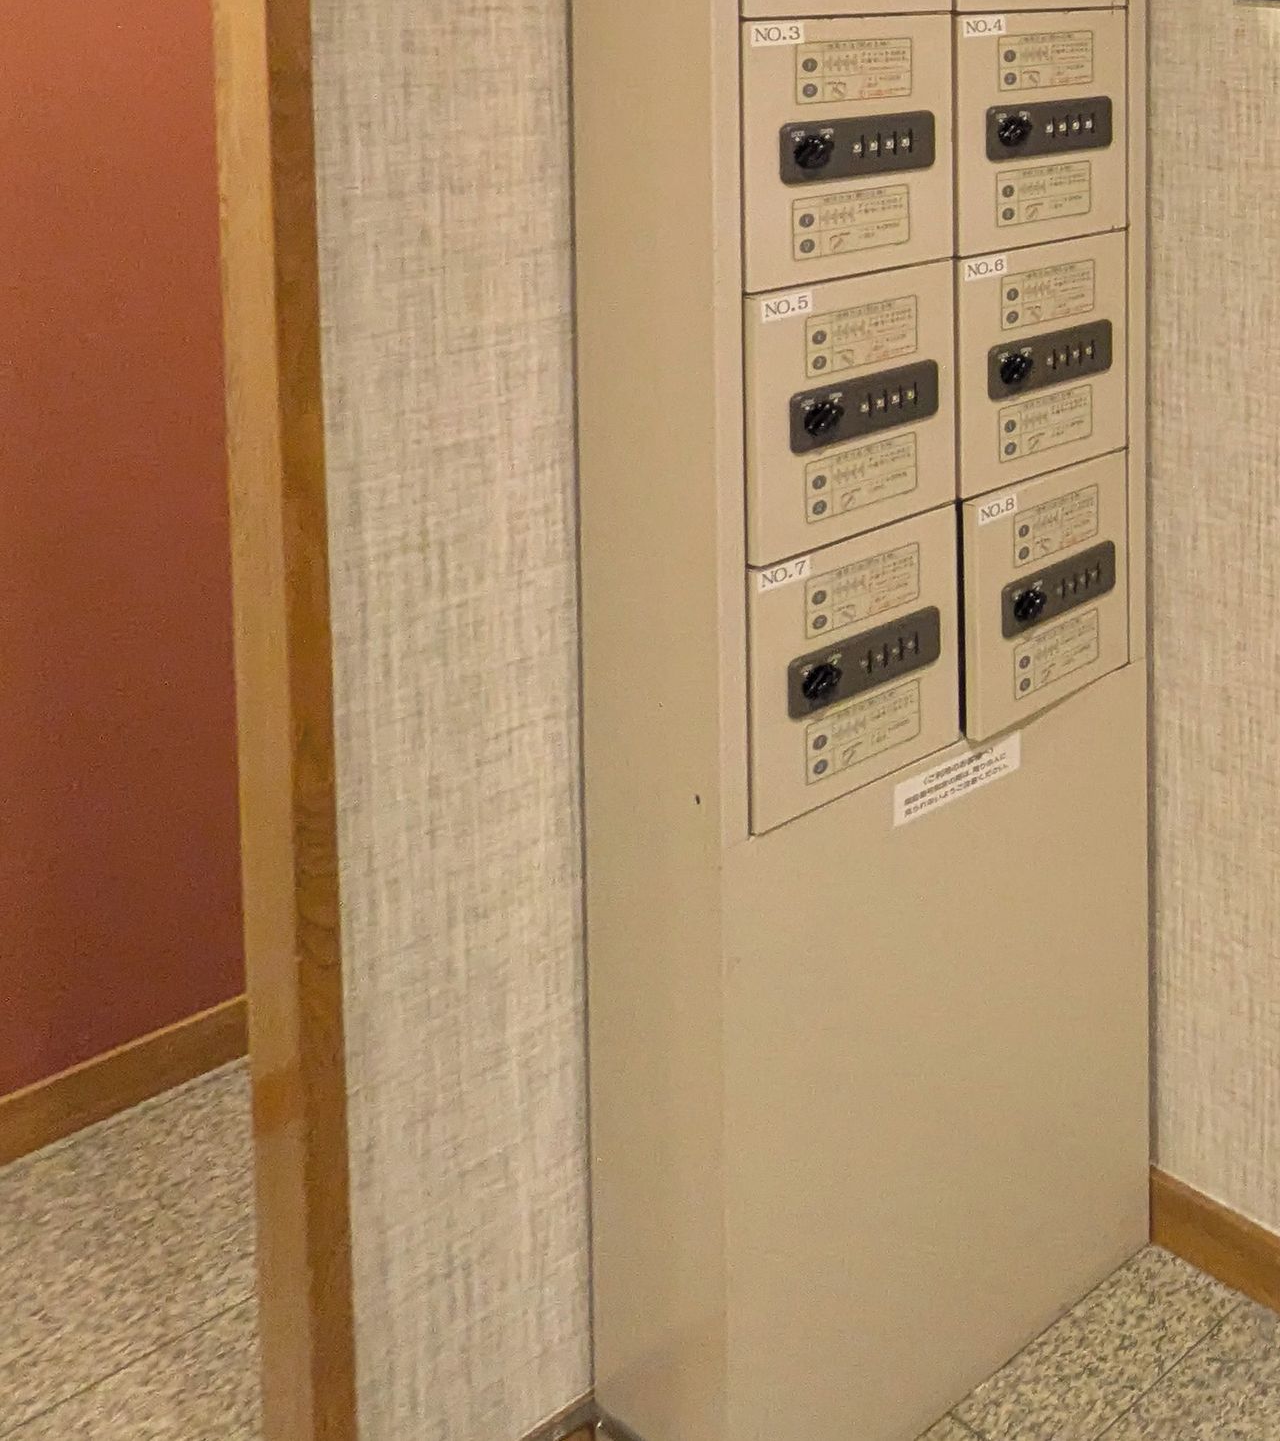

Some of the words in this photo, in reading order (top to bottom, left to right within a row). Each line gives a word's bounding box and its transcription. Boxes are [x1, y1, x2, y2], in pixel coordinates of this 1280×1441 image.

[754, 26, 801, 42] NO.3
[966, 18, 1003, 35] NO.4
[764, 295, 809, 318] NO.5
[761, 559, 807, 588] NO.7
